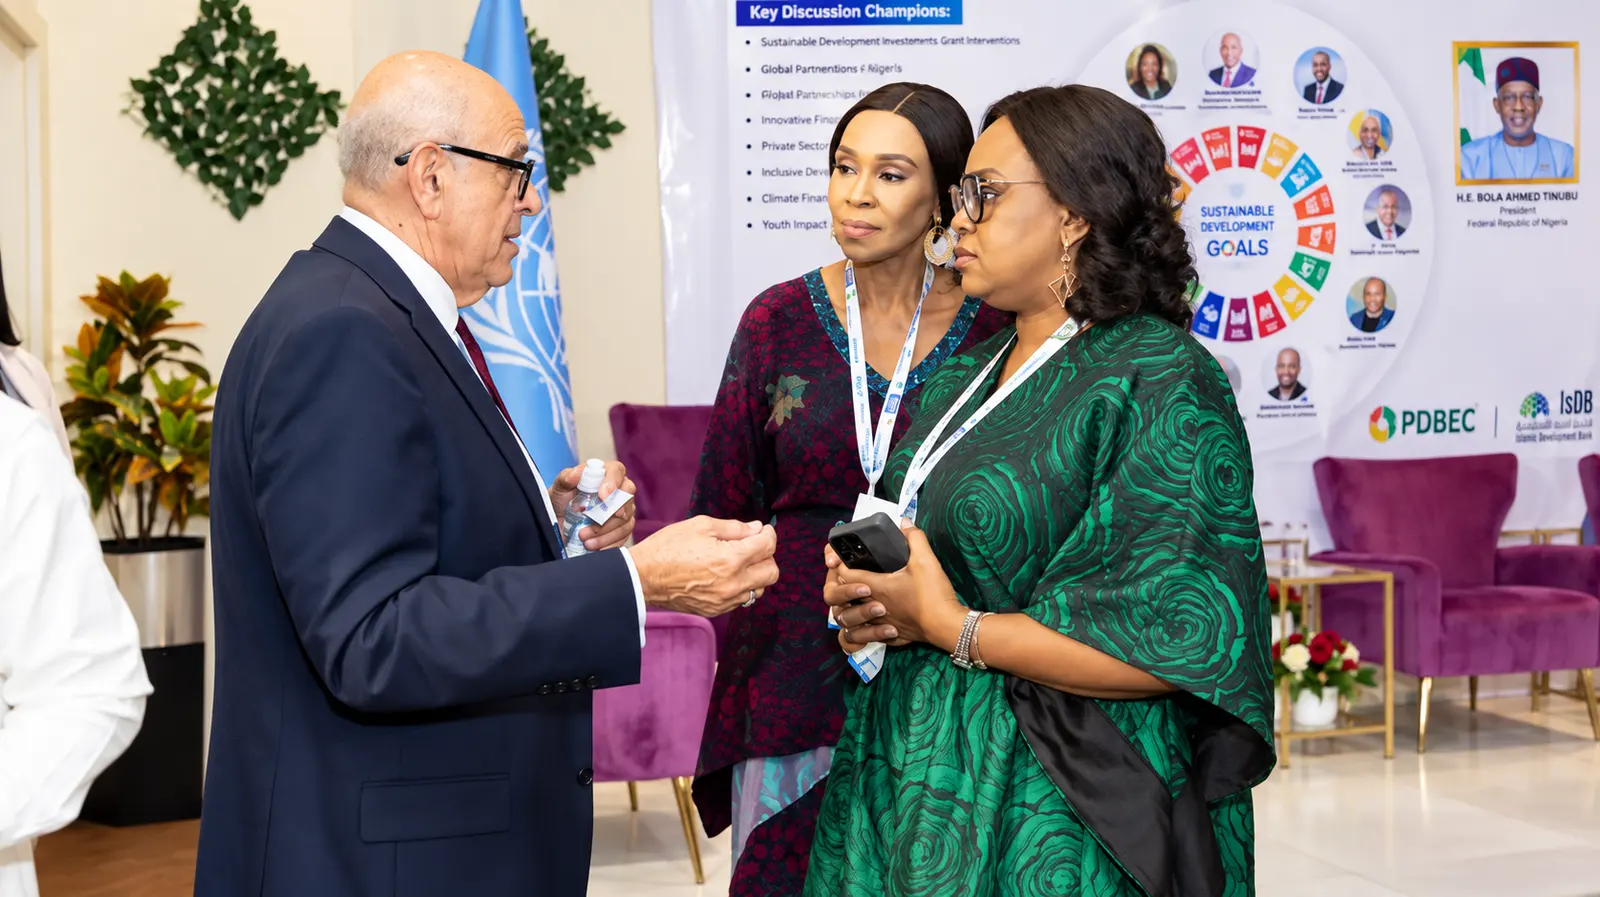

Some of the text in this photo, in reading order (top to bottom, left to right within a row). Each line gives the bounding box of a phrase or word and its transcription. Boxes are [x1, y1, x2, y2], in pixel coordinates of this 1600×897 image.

[750, 4, 951, 22] Key Discussion Champions:
[761, 37, 817, 47] Sustainable
[819, 37, 880, 48] Development
[941, 36, 965, 45] Grant
[966, 36, 1021, 45] Interventions
[761, 64, 793, 74] Global
[761, 115, 812, 124] Innovative
[761, 141, 829, 151] Private Sector
[761, 167, 830, 176] Inclusive Deve
[761, 193, 828, 203] Climate Finan
[1456, 191, 1578, 203] H.E. BOLA AHMED TINUBU
[1200, 205, 1275, 218] SUSTAINABLE
[1499, 206, 1536, 215] President
[762, 219, 828, 231] Youth Impact
[1200, 220, 1275, 233] DEVELOPMENT
[1467, 218, 1568, 228] Federal Republic of Nigeria
[1206, 239, 1269, 257] GOALS
[1560, 389, 1593, 415] IsDB
[1401, 408, 1476, 434] PDBEC
[1515, 430, 1592, 443] Islamic Development Bank
